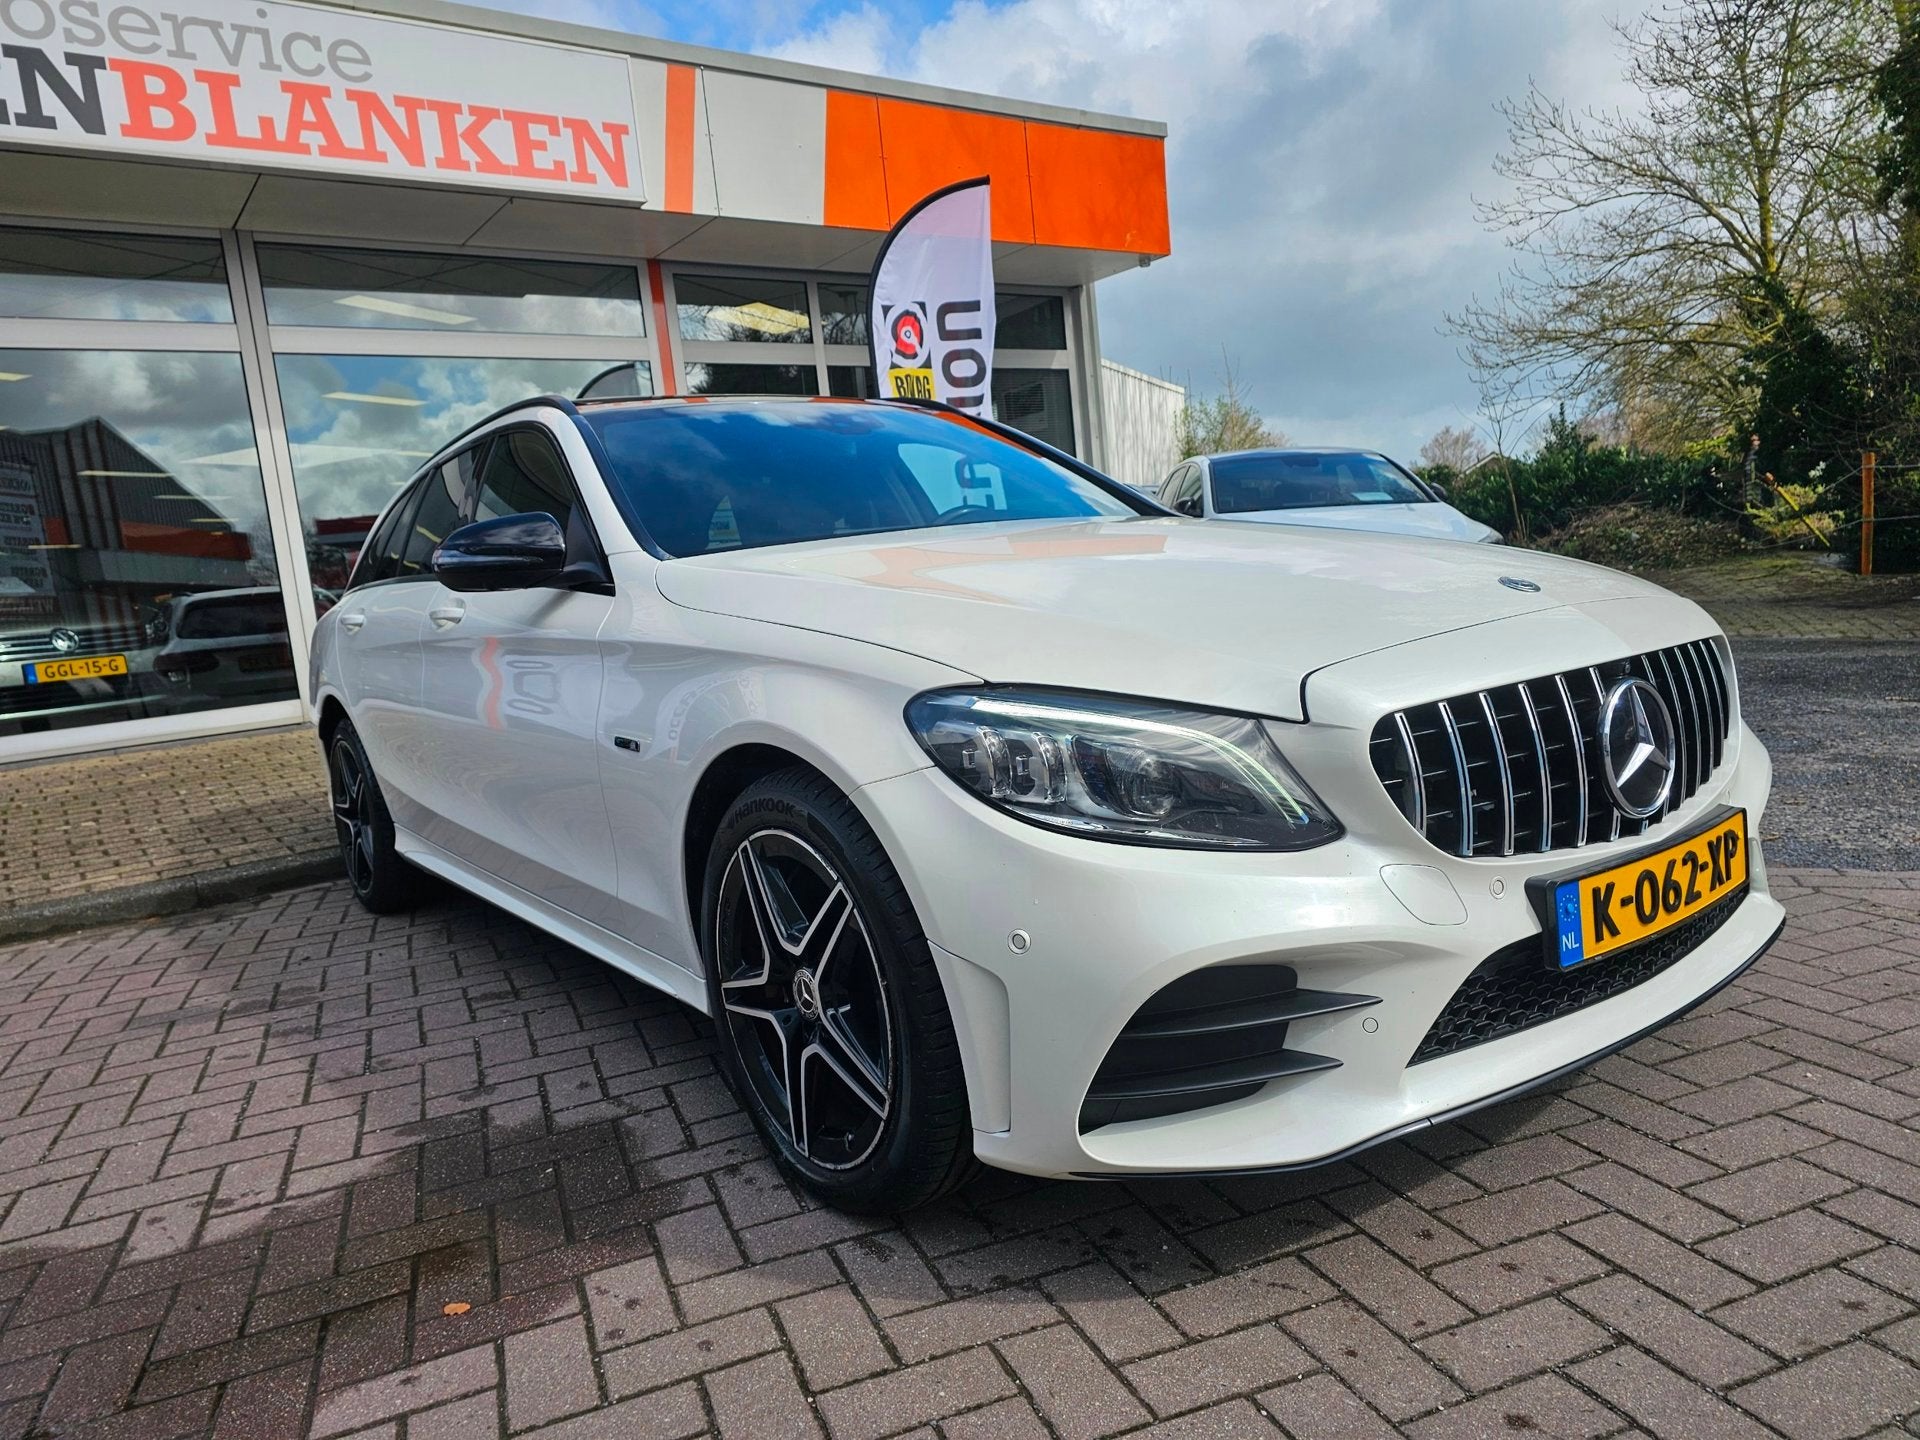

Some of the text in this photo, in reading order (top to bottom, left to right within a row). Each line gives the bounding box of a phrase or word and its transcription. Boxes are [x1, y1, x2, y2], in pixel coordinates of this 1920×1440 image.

[44, 658, 119, 679] GGL-15-G
[1592, 828, 1739, 943] K-062-XP
[1562, 932, 1580, 951] NL
